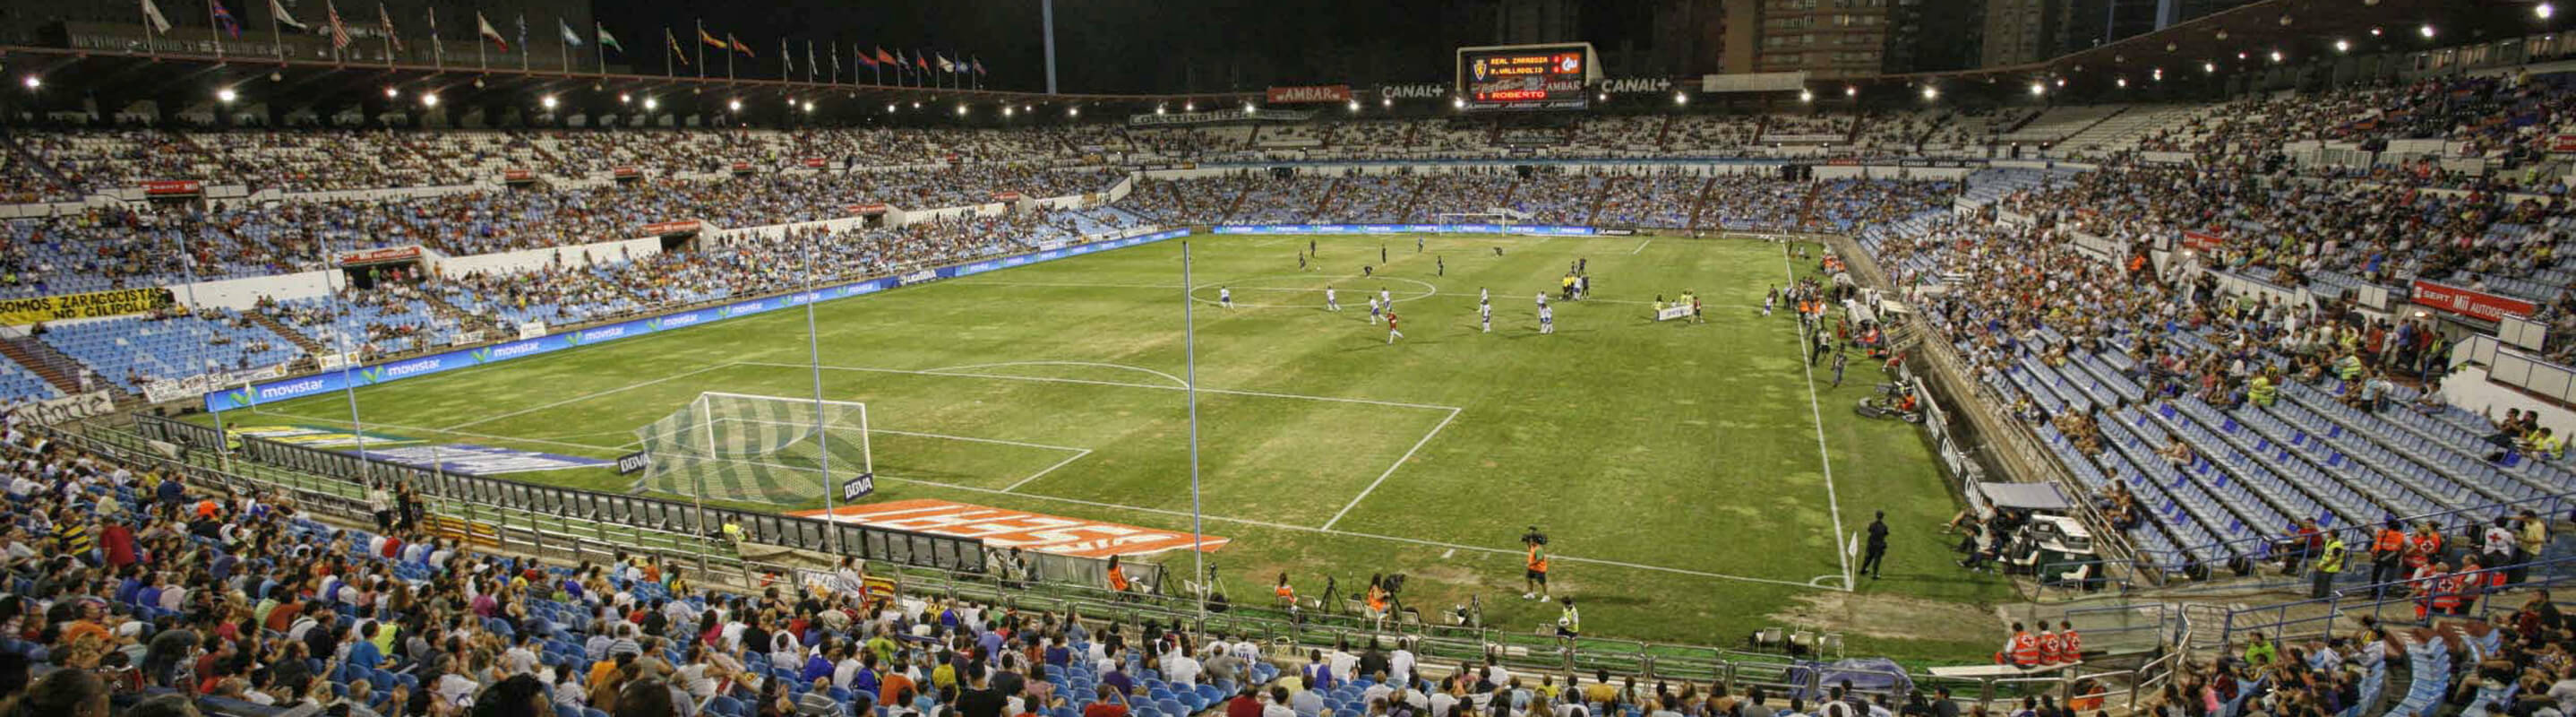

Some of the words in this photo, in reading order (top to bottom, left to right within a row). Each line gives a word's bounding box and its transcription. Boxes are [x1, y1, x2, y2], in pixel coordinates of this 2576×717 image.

[1381, 85, 1444, 99] CANAL+
[1547, 81, 1582, 91] AMBAR
[1601, 78, 1671, 93] CANAL+
[1284, 89, 1332, 102] AMBAR
[0, 298, 51, 313] SOMOS
[2452, 294, 2470, 311] Mii
[53, 309, 76, 320] NO
[586, 326, 624, 341] movistar
[494, 342, 538, 358] movistar
[388, 358, 441, 376] movistar
[262, 378, 324, 399] movistar
[620, 454, 651, 474] BBVA
[845, 476, 872, 499] BBVA
